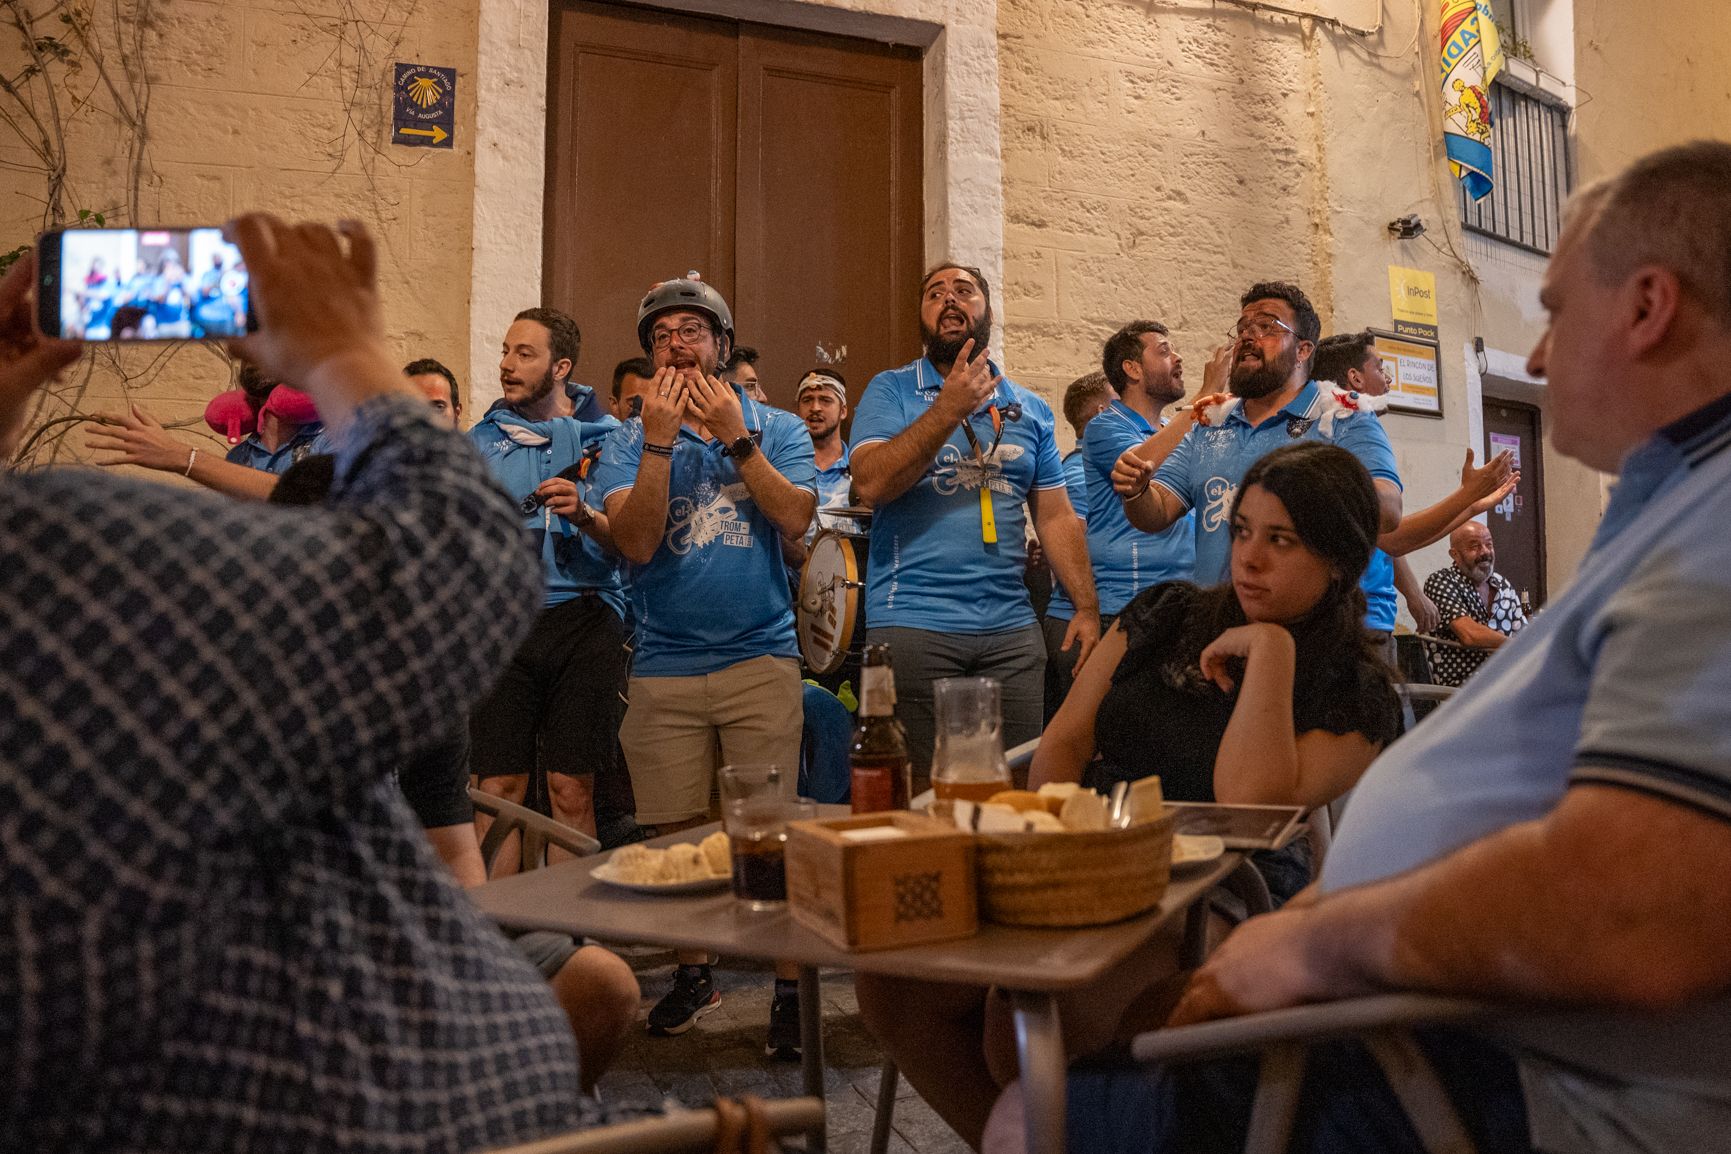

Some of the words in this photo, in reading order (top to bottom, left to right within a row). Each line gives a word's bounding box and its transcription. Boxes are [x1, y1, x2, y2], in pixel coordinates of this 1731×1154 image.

[398, 68, 416, 86] CAMINO
[428, 68, 452, 91] SANTIAGO
[418, 110, 443, 119] AUGUSTA
[1407, 285, 1431, 300] InPost
[1398, 325, 1418, 335] Punto
[1418, 328, 1434, 337] Pack
[725, 534, 744, 546] PETA
